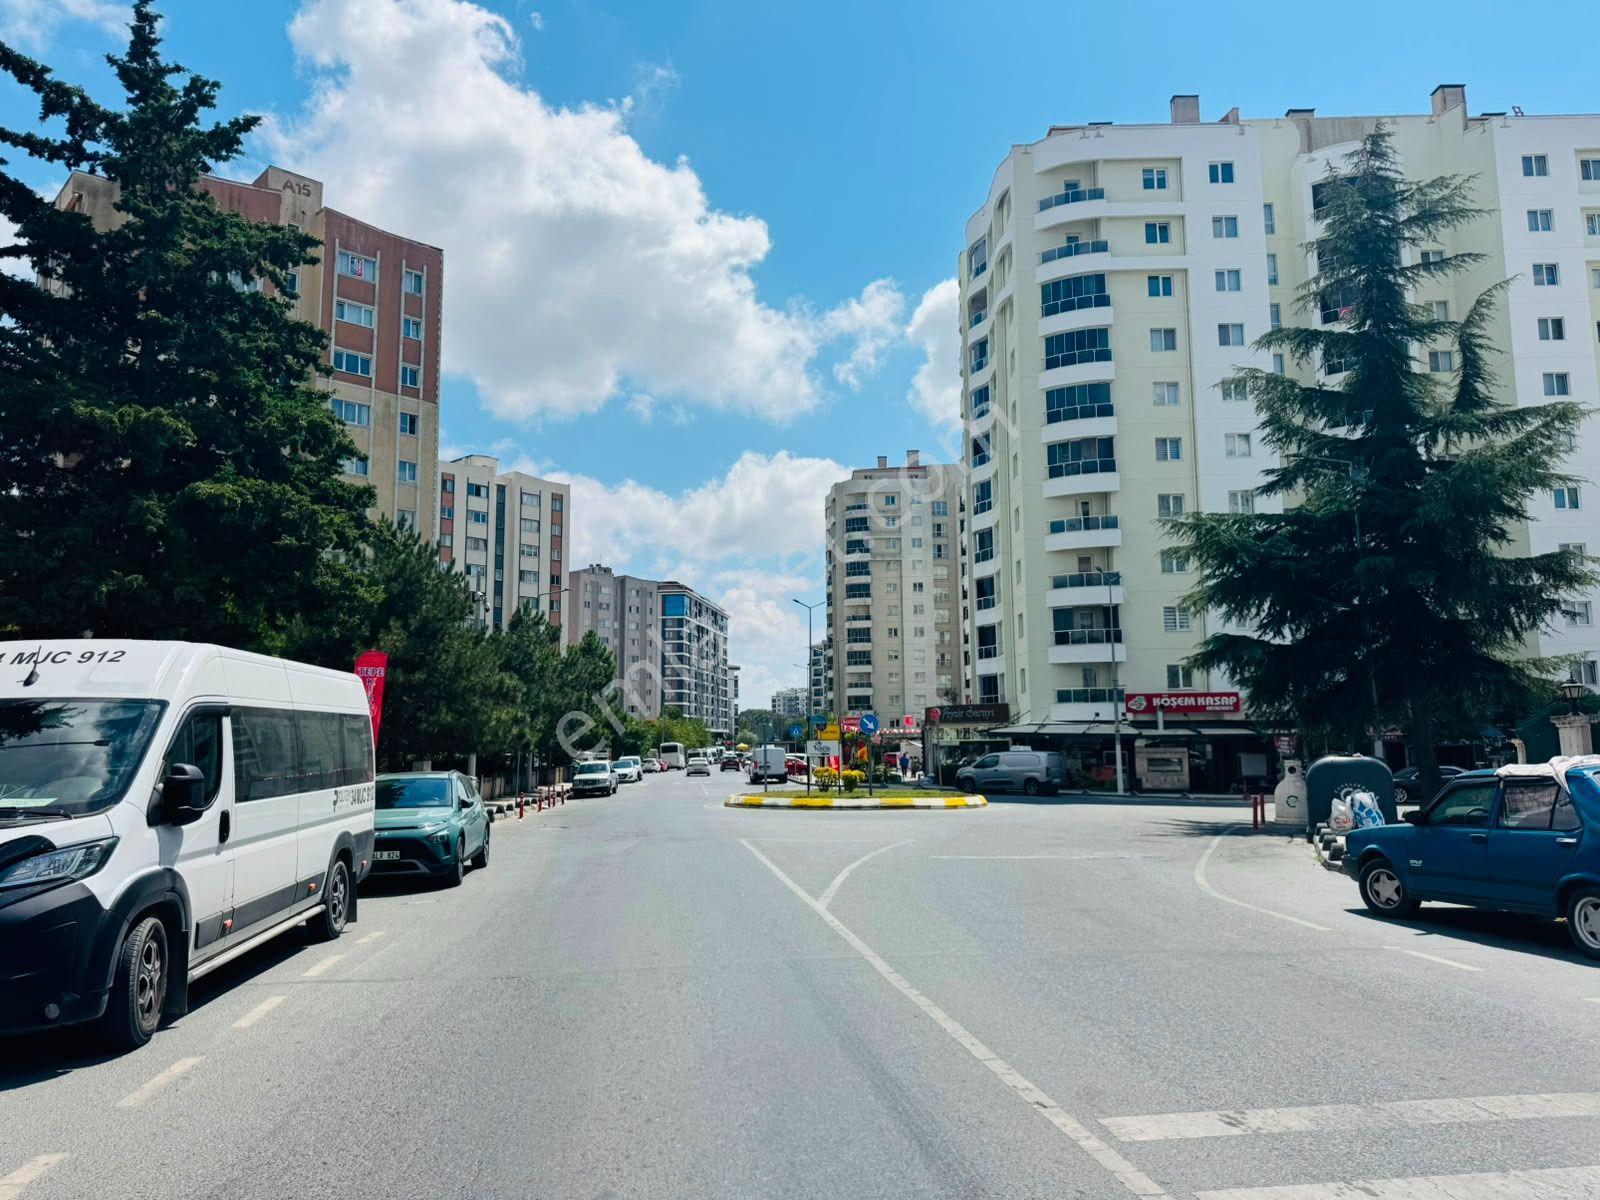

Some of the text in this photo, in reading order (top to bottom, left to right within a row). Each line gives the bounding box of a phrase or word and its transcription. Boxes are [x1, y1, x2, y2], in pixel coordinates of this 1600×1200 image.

[282, 179, 312, 198] A15
[9, 650, 72, 665] MJC
[77, 649, 127, 664] 912
[357, 666, 385, 677] TEPE
[1152, 693, 1196, 709] KÖŞEM
[1197, 696, 1238, 706] KASAP
